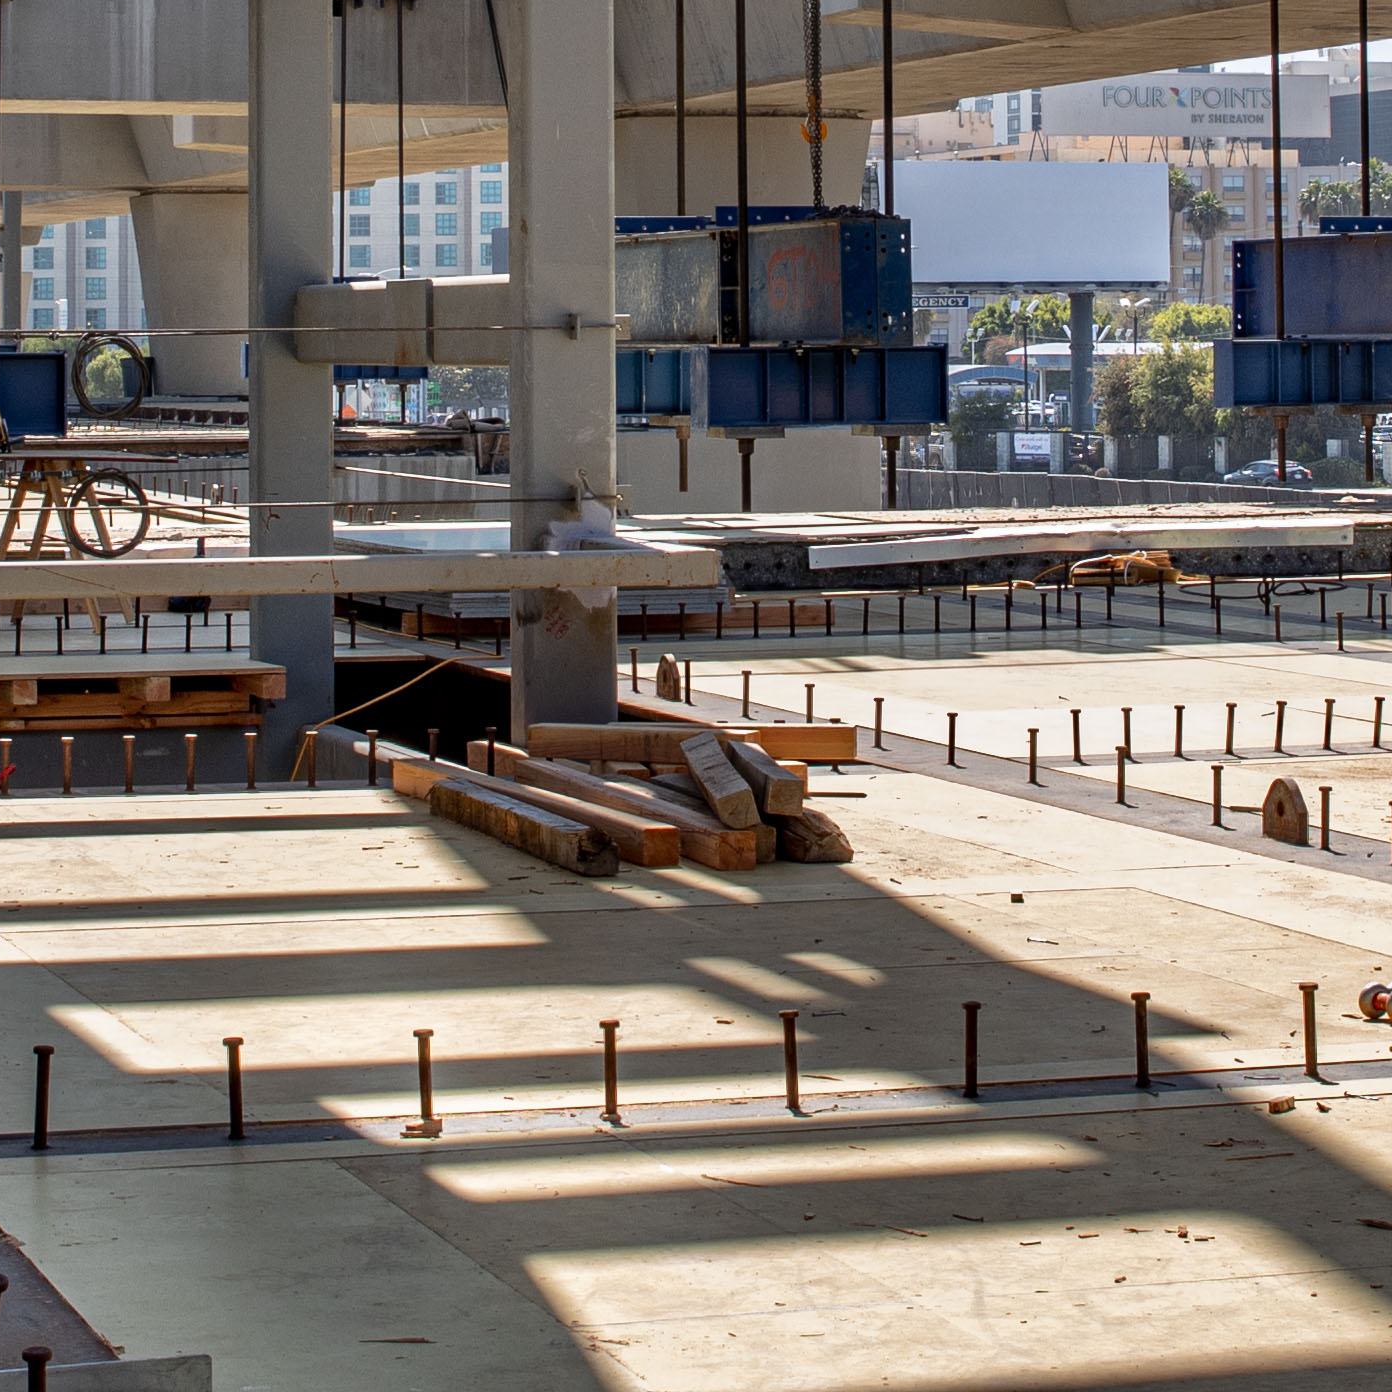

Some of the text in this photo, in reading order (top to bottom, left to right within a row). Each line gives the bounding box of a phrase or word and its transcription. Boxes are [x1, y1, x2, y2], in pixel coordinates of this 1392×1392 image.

[1102, 85, 1272, 109] FOUR POINTS
[1191, 113, 1265, 125] BY SHERATON
